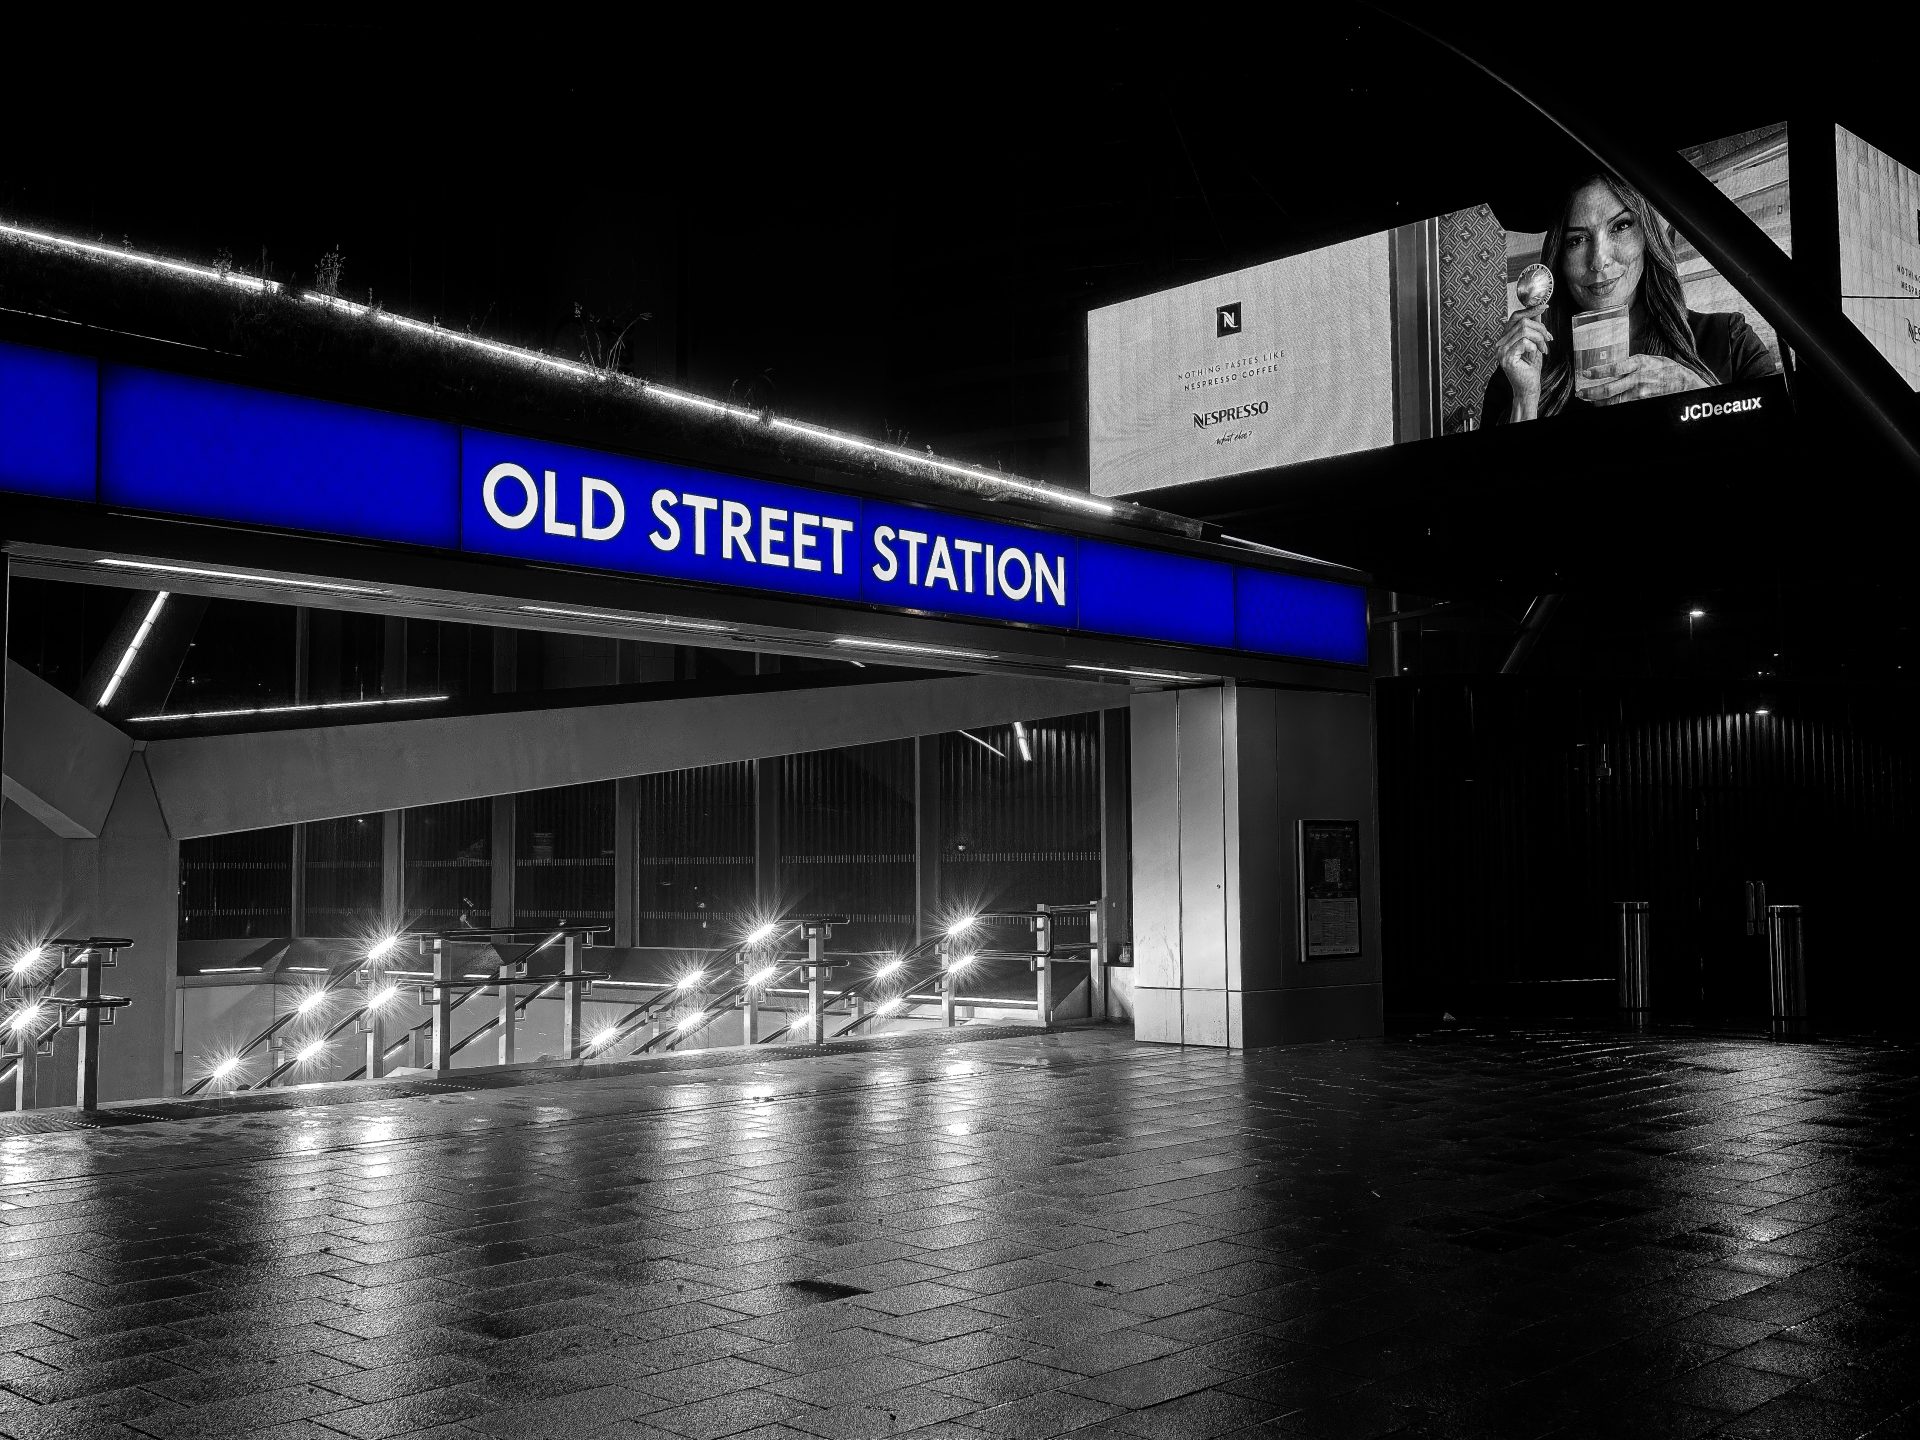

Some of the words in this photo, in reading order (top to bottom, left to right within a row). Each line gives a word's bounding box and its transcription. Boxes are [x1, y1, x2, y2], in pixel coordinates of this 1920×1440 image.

[1178, 364, 1221, 380] NOTHING
[1225, 355, 1259, 370] TASTES
[1263, 349, 1285, 362] LIKE
[1184, 373, 1237, 391] NESPRESSO
[1242, 364, 1278, 379] COFFEE
[1192, 400, 1269, 430] NESPRESSO
[1680, 396, 1763, 422] JCDecaux
[481, 461, 626, 542] OLD
[648, 488, 855, 575] STREET
[871, 524, 1067, 608] STATION
